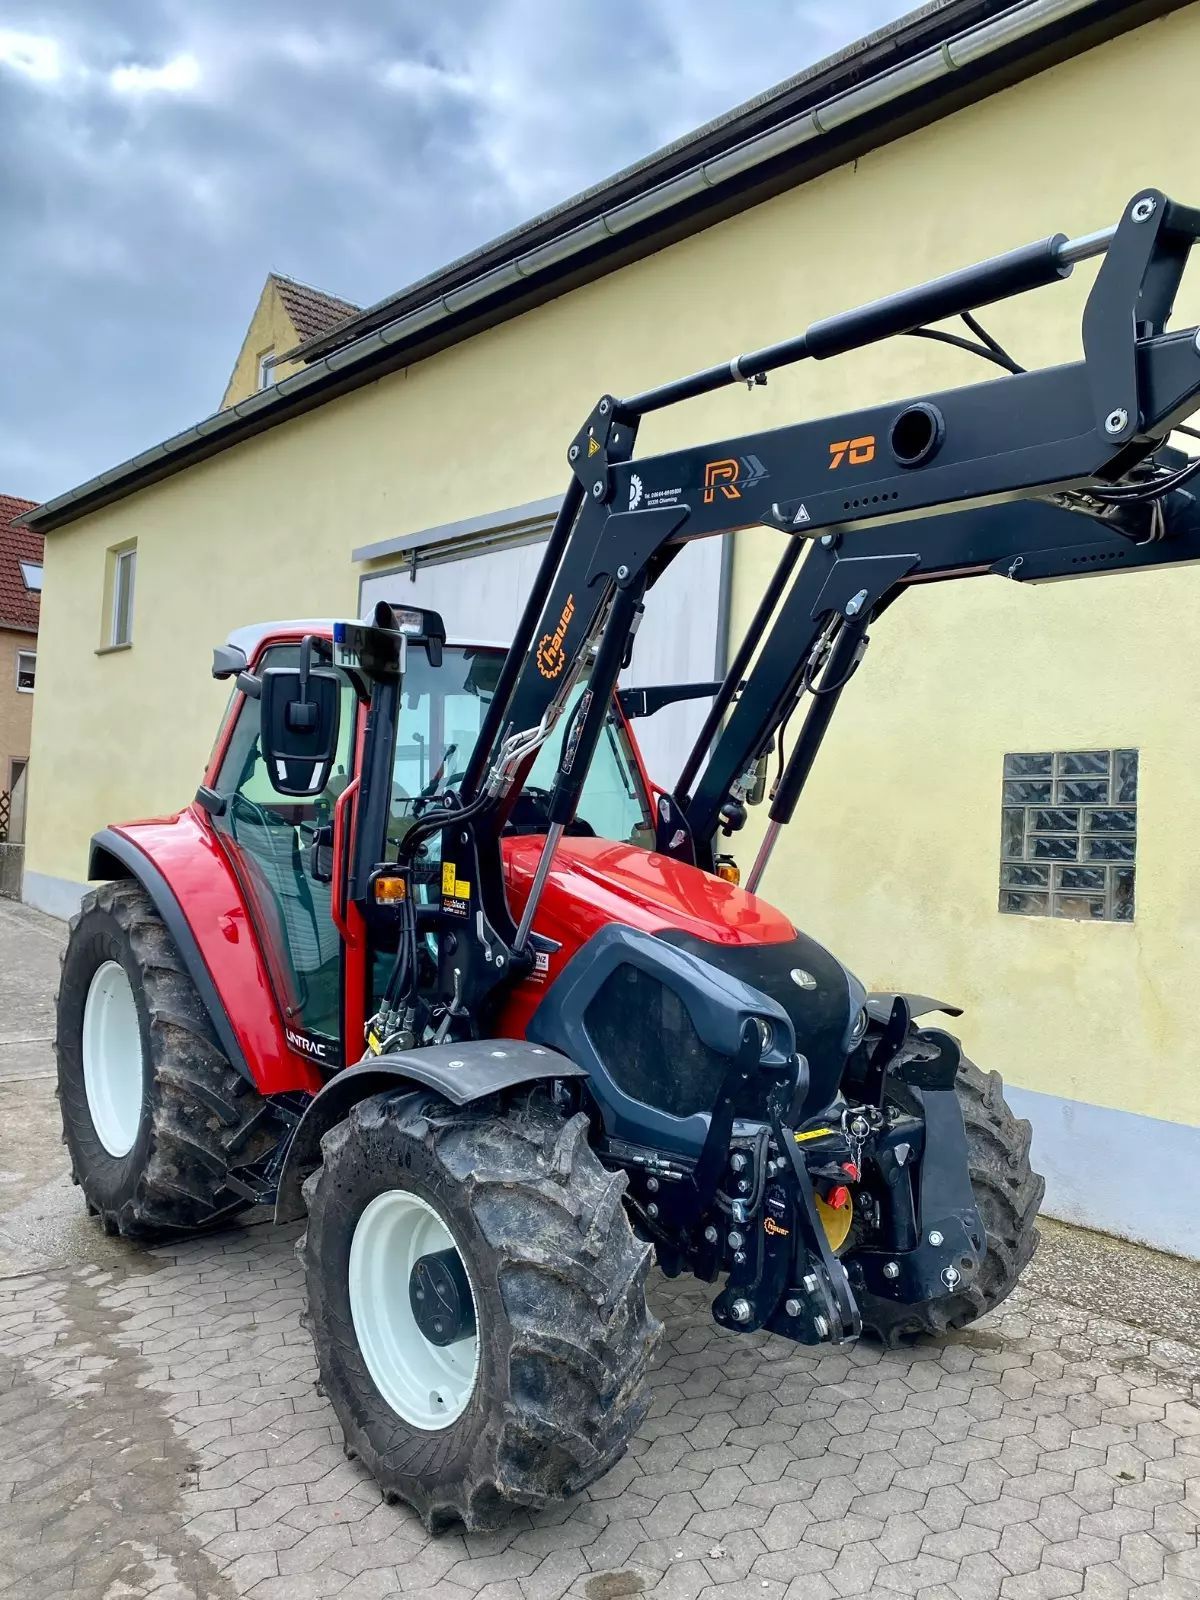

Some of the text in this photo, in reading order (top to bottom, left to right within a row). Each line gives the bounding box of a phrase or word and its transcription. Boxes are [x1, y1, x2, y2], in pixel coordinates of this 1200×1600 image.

[829, 435, 875, 470] 70
[704, 459, 741, 503] R
[543, 593, 575, 667] hauer
[341, 647, 363, 667] HN
[285, 1027, 326, 1057] LINTRAC
